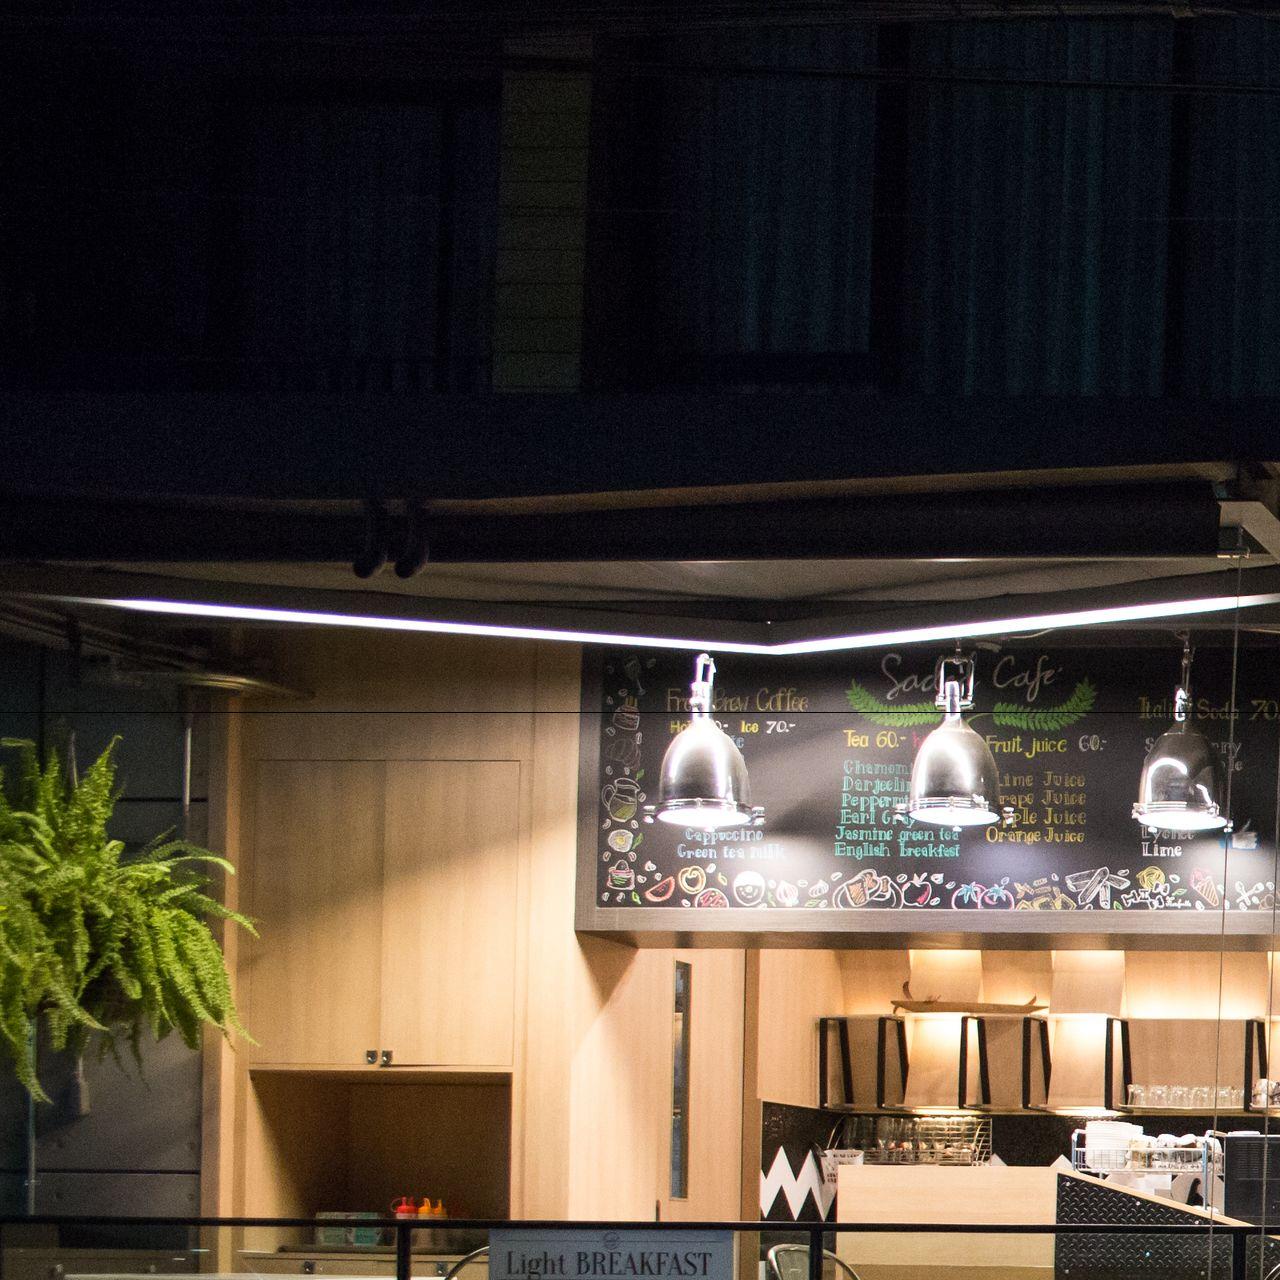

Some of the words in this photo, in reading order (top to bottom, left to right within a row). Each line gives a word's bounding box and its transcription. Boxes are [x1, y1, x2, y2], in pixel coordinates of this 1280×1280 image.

[757, 688, 809, 711] Coffee
[1197, 699, 1239, 719] Soda
[670, 721, 692, 733] Ho
[766, 721, 796, 733] 70.-
[843, 729, 869, 747] Tea
[876, 731, 906, 748] 60.-
[986, 735, 1022, 752] Fruit
[1024, 738, 1068, 758] juice
[842, 776, 912, 794] Darjeeli
[1043, 771, 1086, 787] Juice
[999, 793, 1034, 808] rape
[1042, 790, 1086, 805] Juice
[841, 809, 876, 825] Earl
[1044, 807, 1087, 824] Juice
[685, 828, 763, 846] Cappuccino
[835, 826, 893, 841] Jasmine
[899, 828, 934, 843] green
[940, 827, 960, 841] tea
[986, 826, 1041, 844] Orange
[1044, 827, 1085, 842] Juice
[677, 844, 717, 859] Green
[723, 846, 745, 859] tea
[834, 842, 891, 860] English
[899, 843, 960, 858] breakfast
[1141, 841, 1182, 857] Lime
[577, 1251, 712, 1277] BREAKFAST
